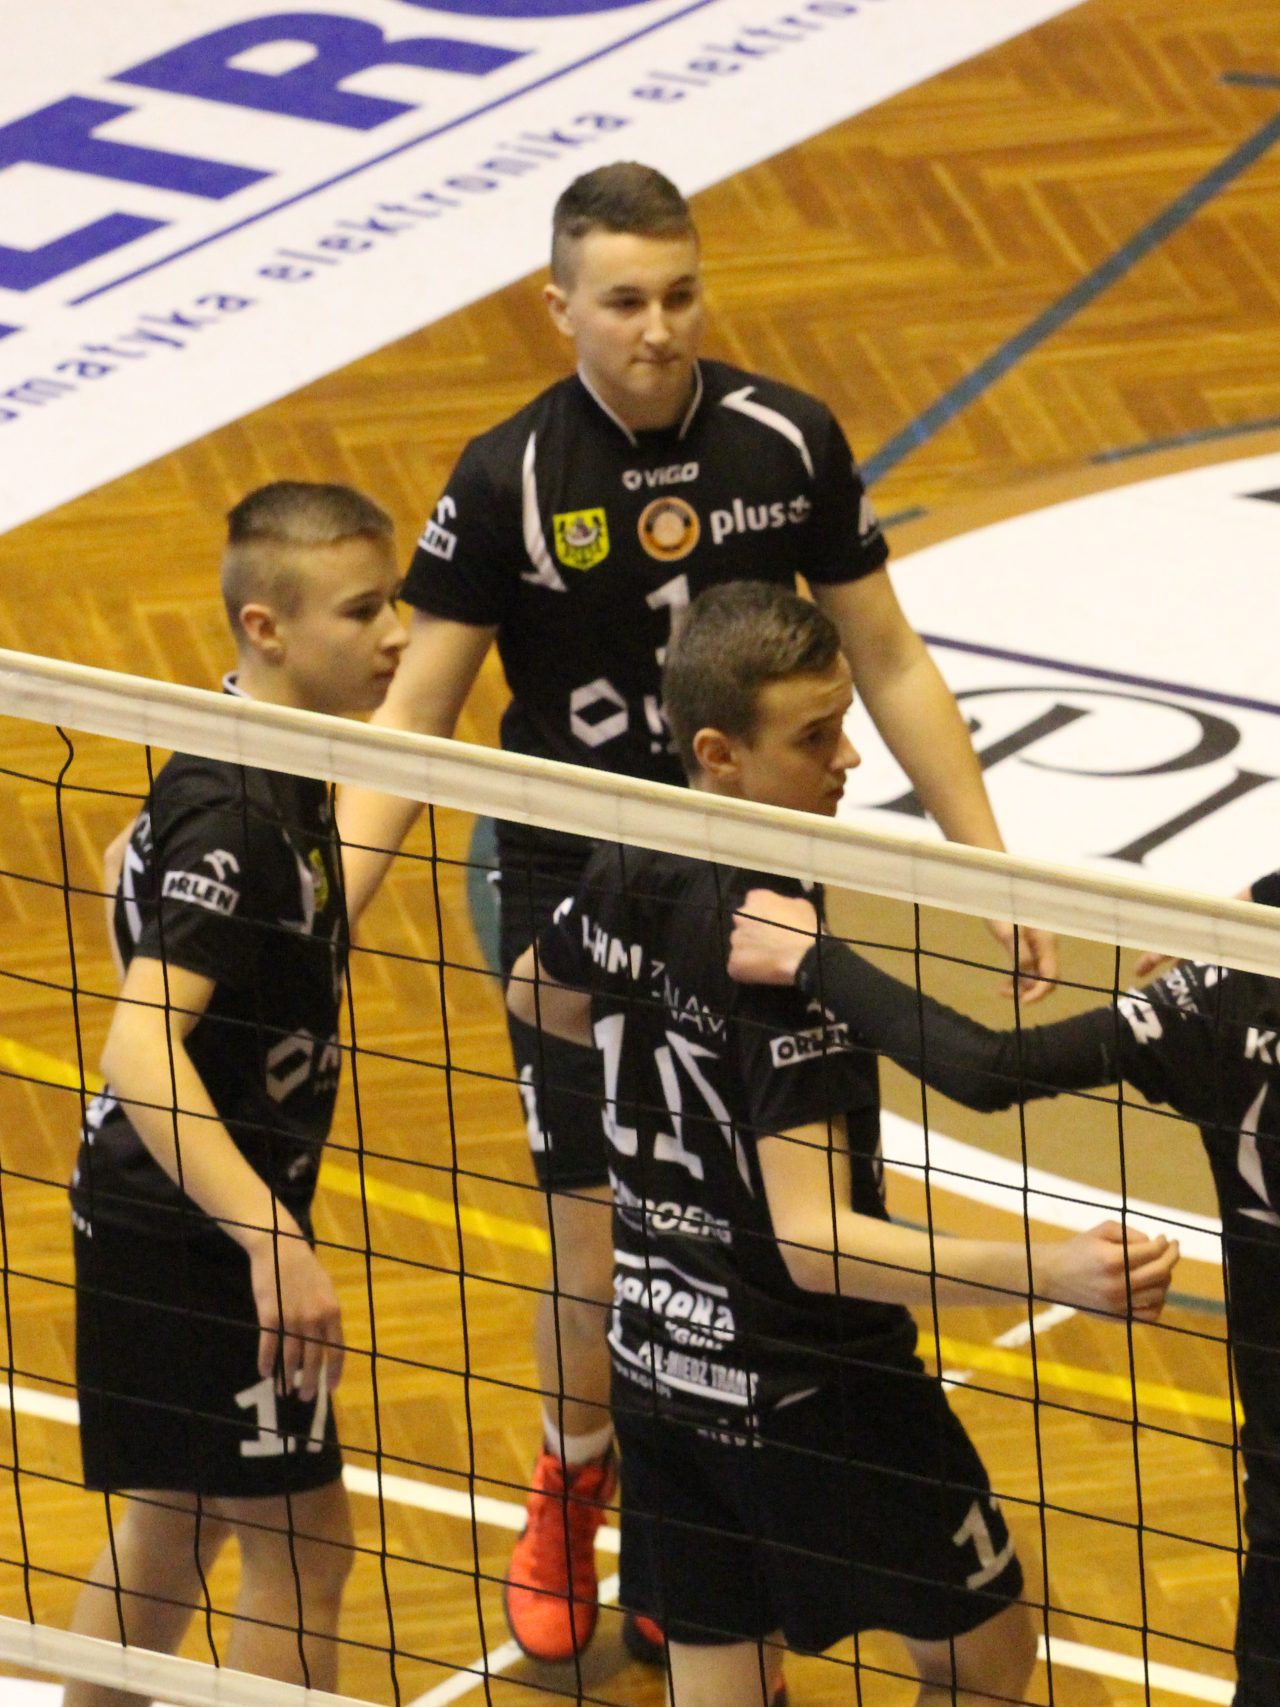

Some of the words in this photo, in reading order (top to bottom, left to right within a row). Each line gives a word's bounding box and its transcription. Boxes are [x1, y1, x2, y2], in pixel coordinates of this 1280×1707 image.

[257, 111, 632, 284] elektronika
[644, 461, 700, 488] VIGO
[710, 499, 786, 545] plus
